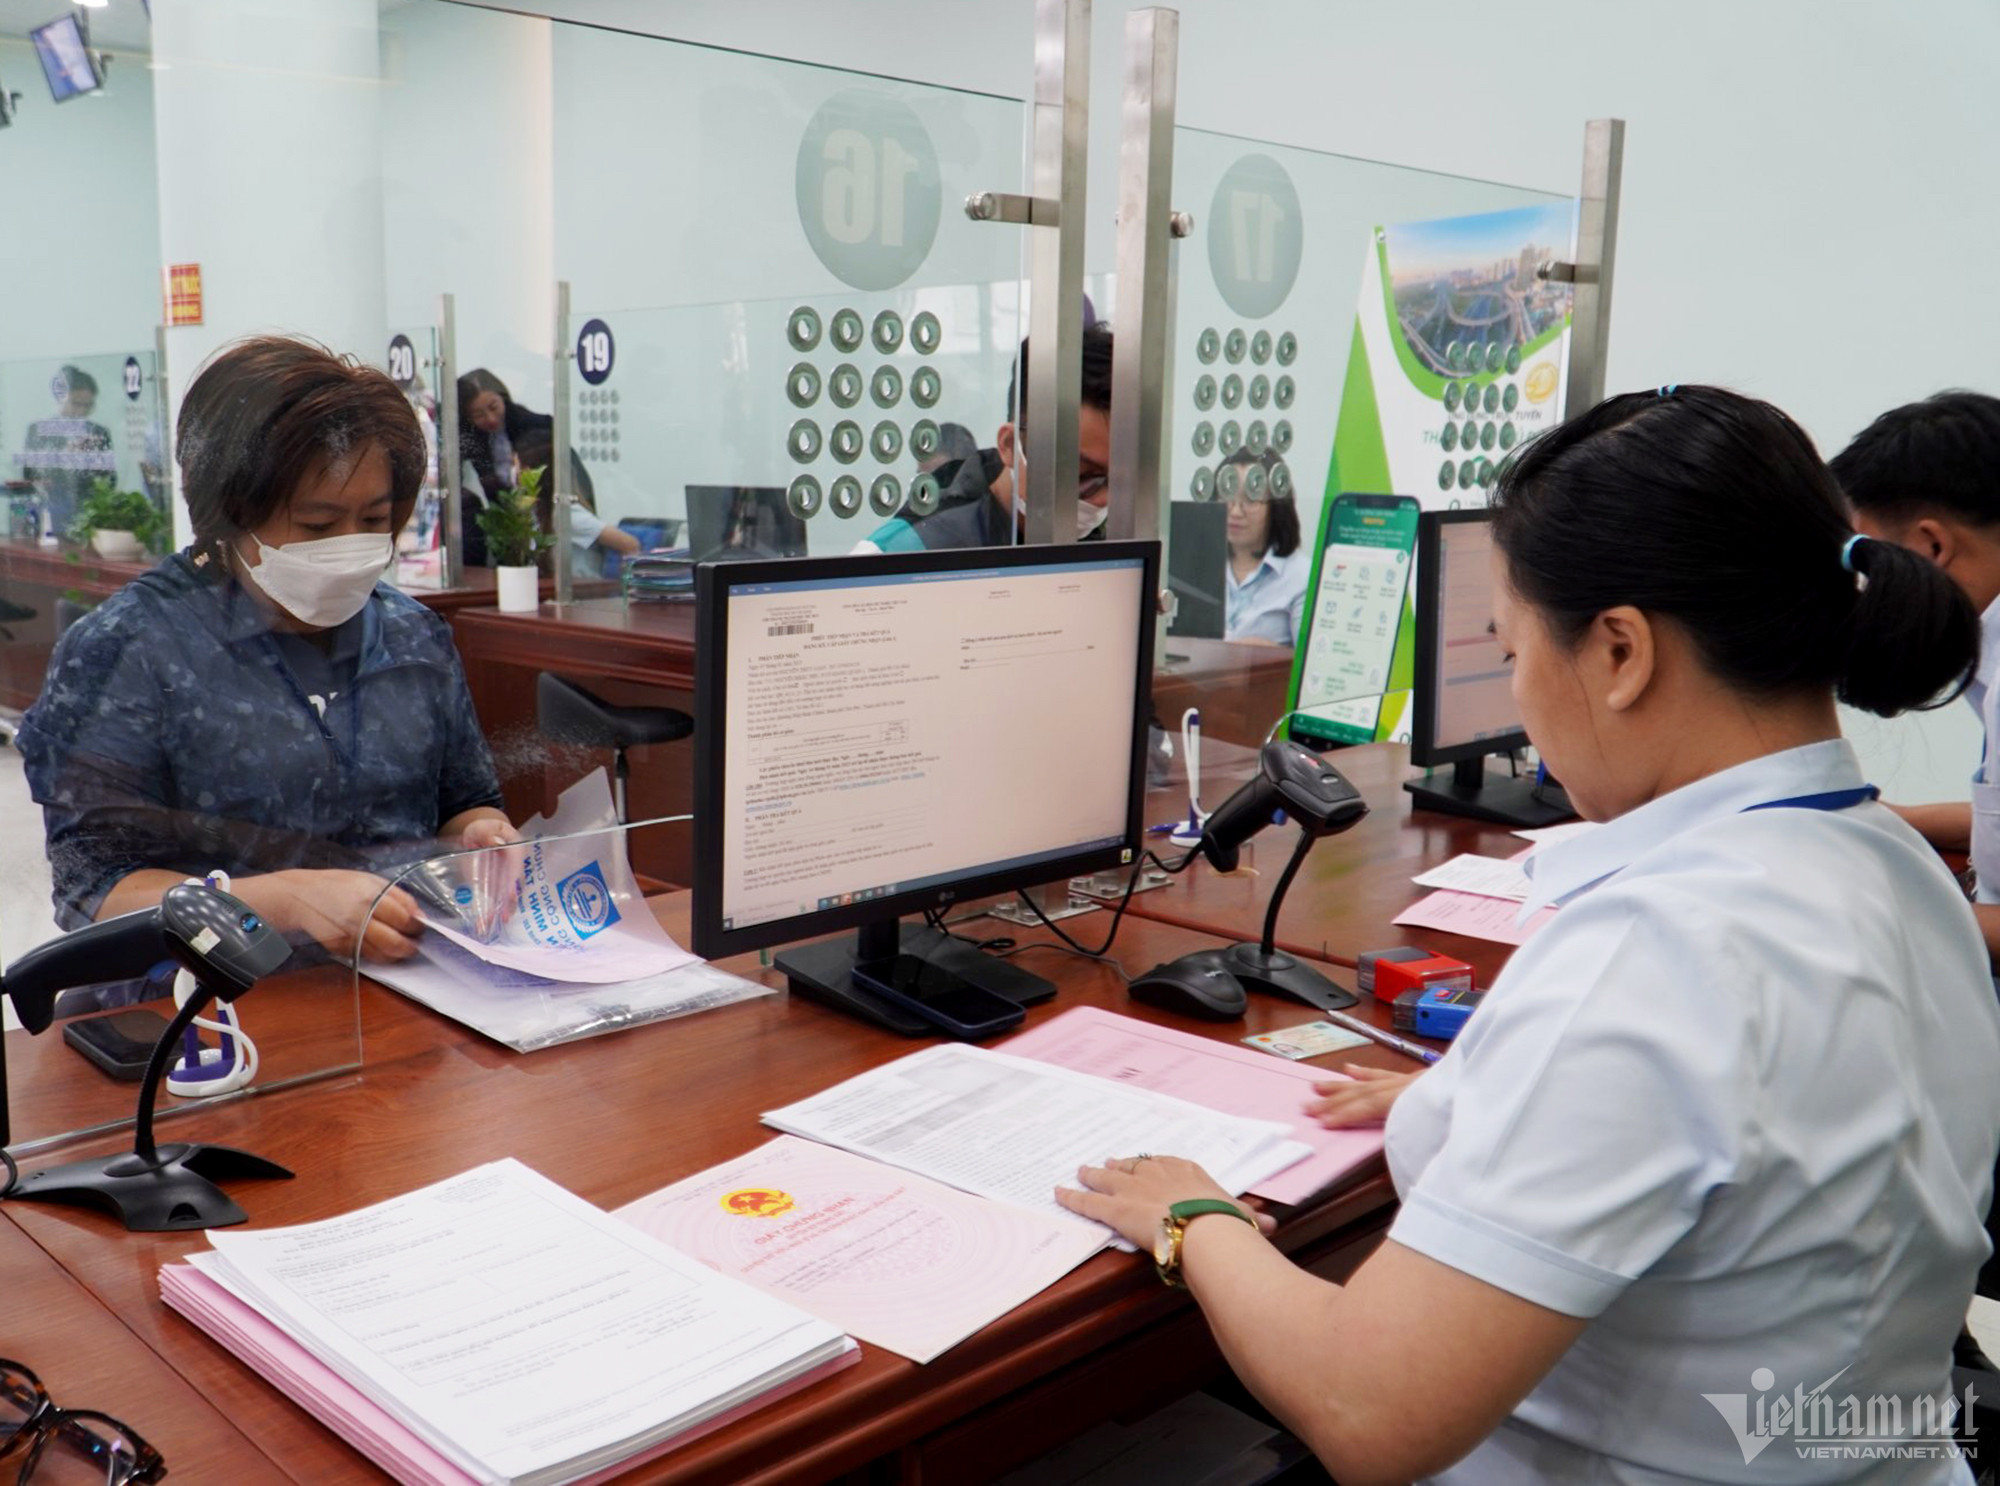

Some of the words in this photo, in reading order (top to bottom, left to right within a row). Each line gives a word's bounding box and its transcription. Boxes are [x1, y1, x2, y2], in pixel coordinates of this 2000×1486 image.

[390, 345, 414, 381] 20
[581, 331, 610, 372] 19
[125, 364, 140, 393] 22
